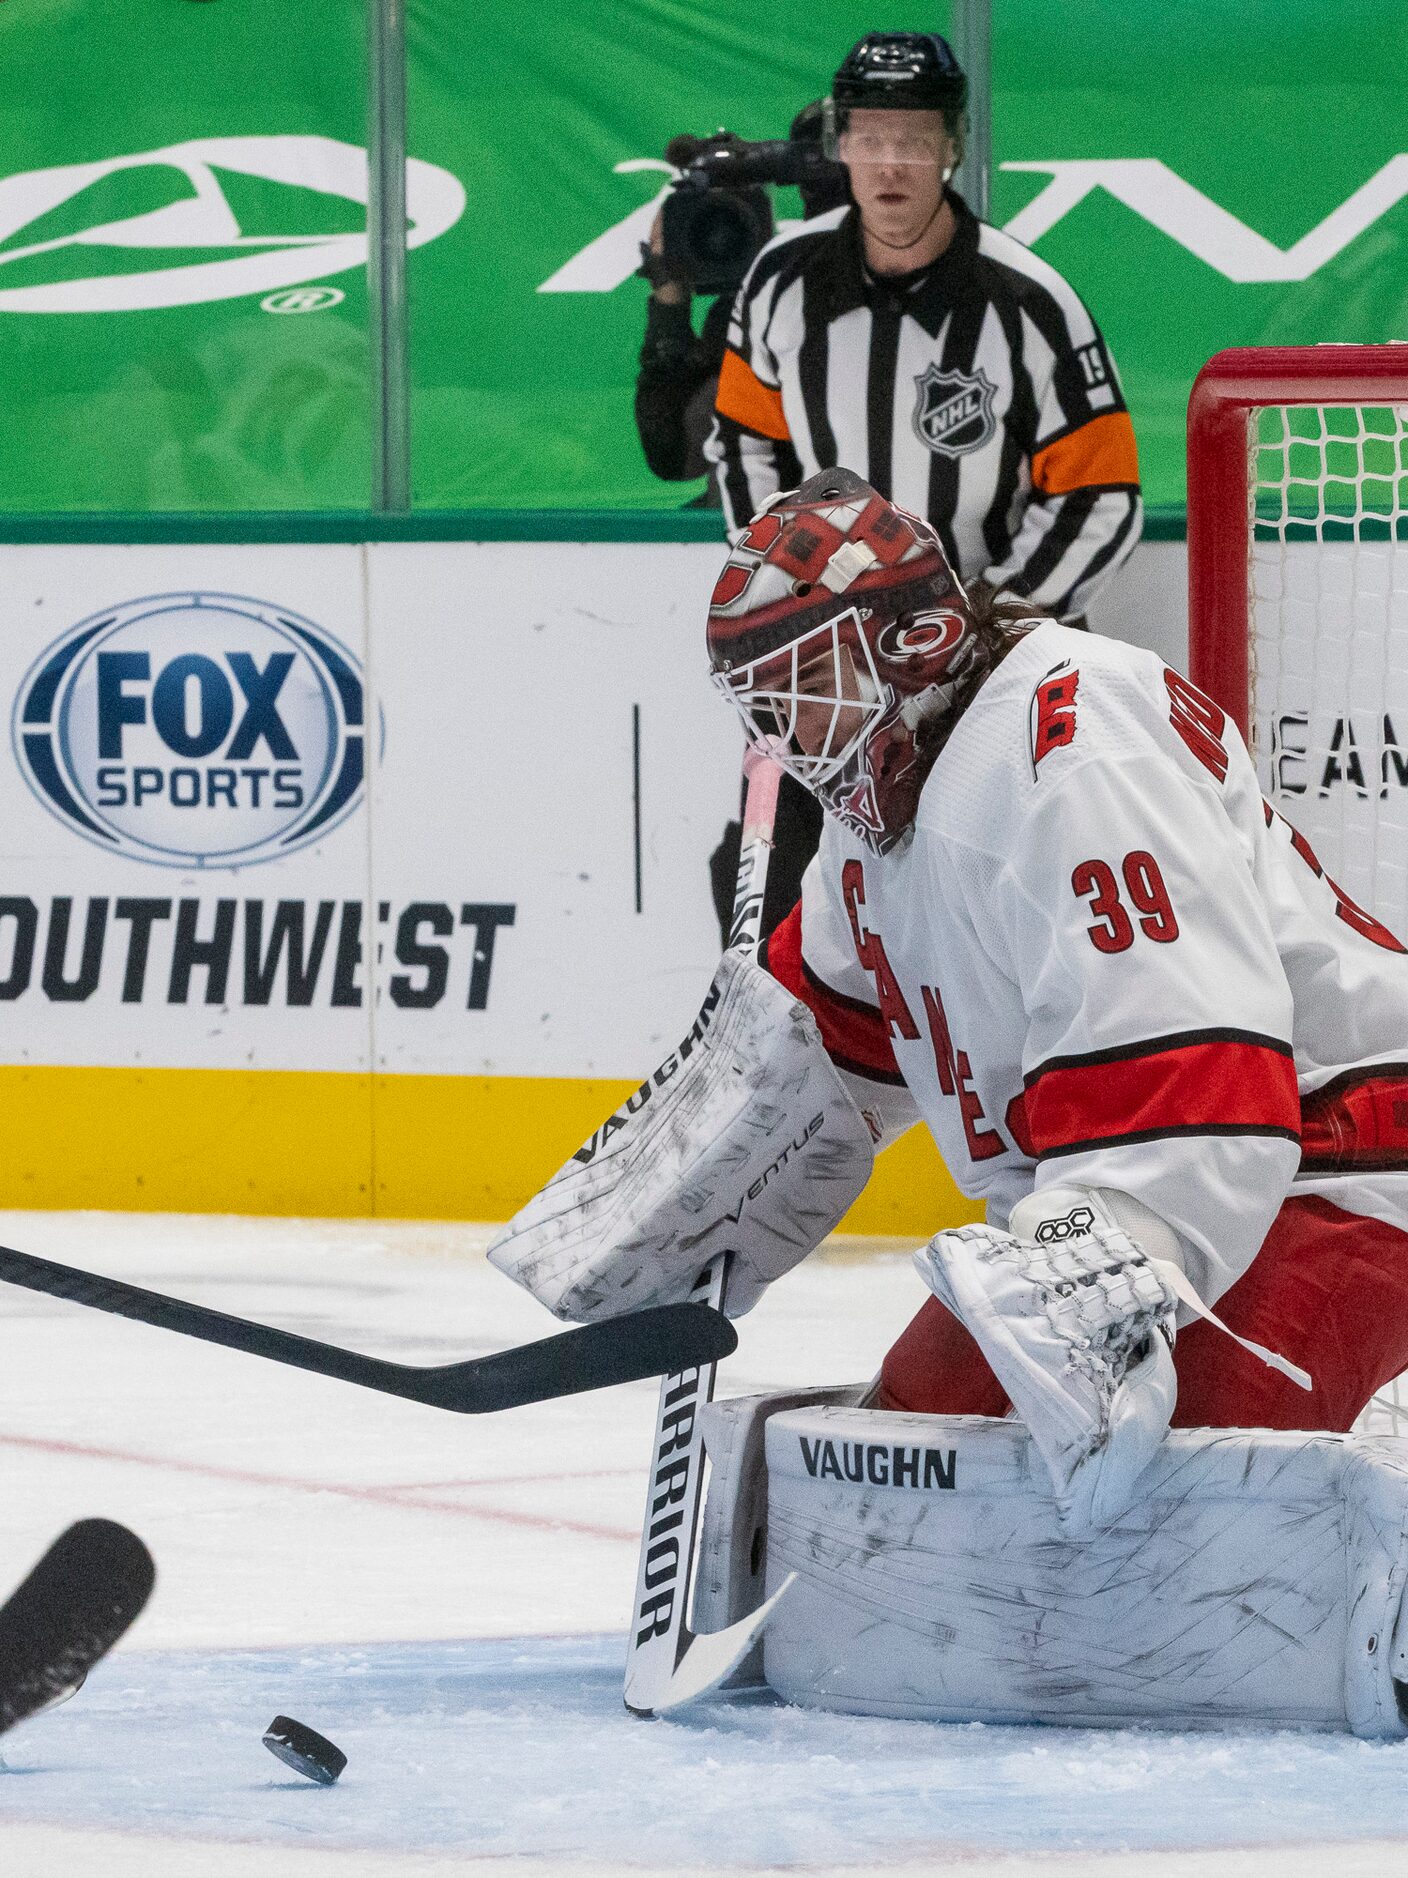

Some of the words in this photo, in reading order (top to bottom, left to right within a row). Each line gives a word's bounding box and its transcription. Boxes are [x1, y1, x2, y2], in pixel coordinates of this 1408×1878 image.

[930, 395, 980, 438] NHL
[96, 650, 301, 761] FOX
[95, 767, 305, 809] SPORTS
[1071, 850, 1180, 954] 39
[636, 1268, 712, 1652] ARRIOR
[799, 1436, 957, 1490] VAUGHN
